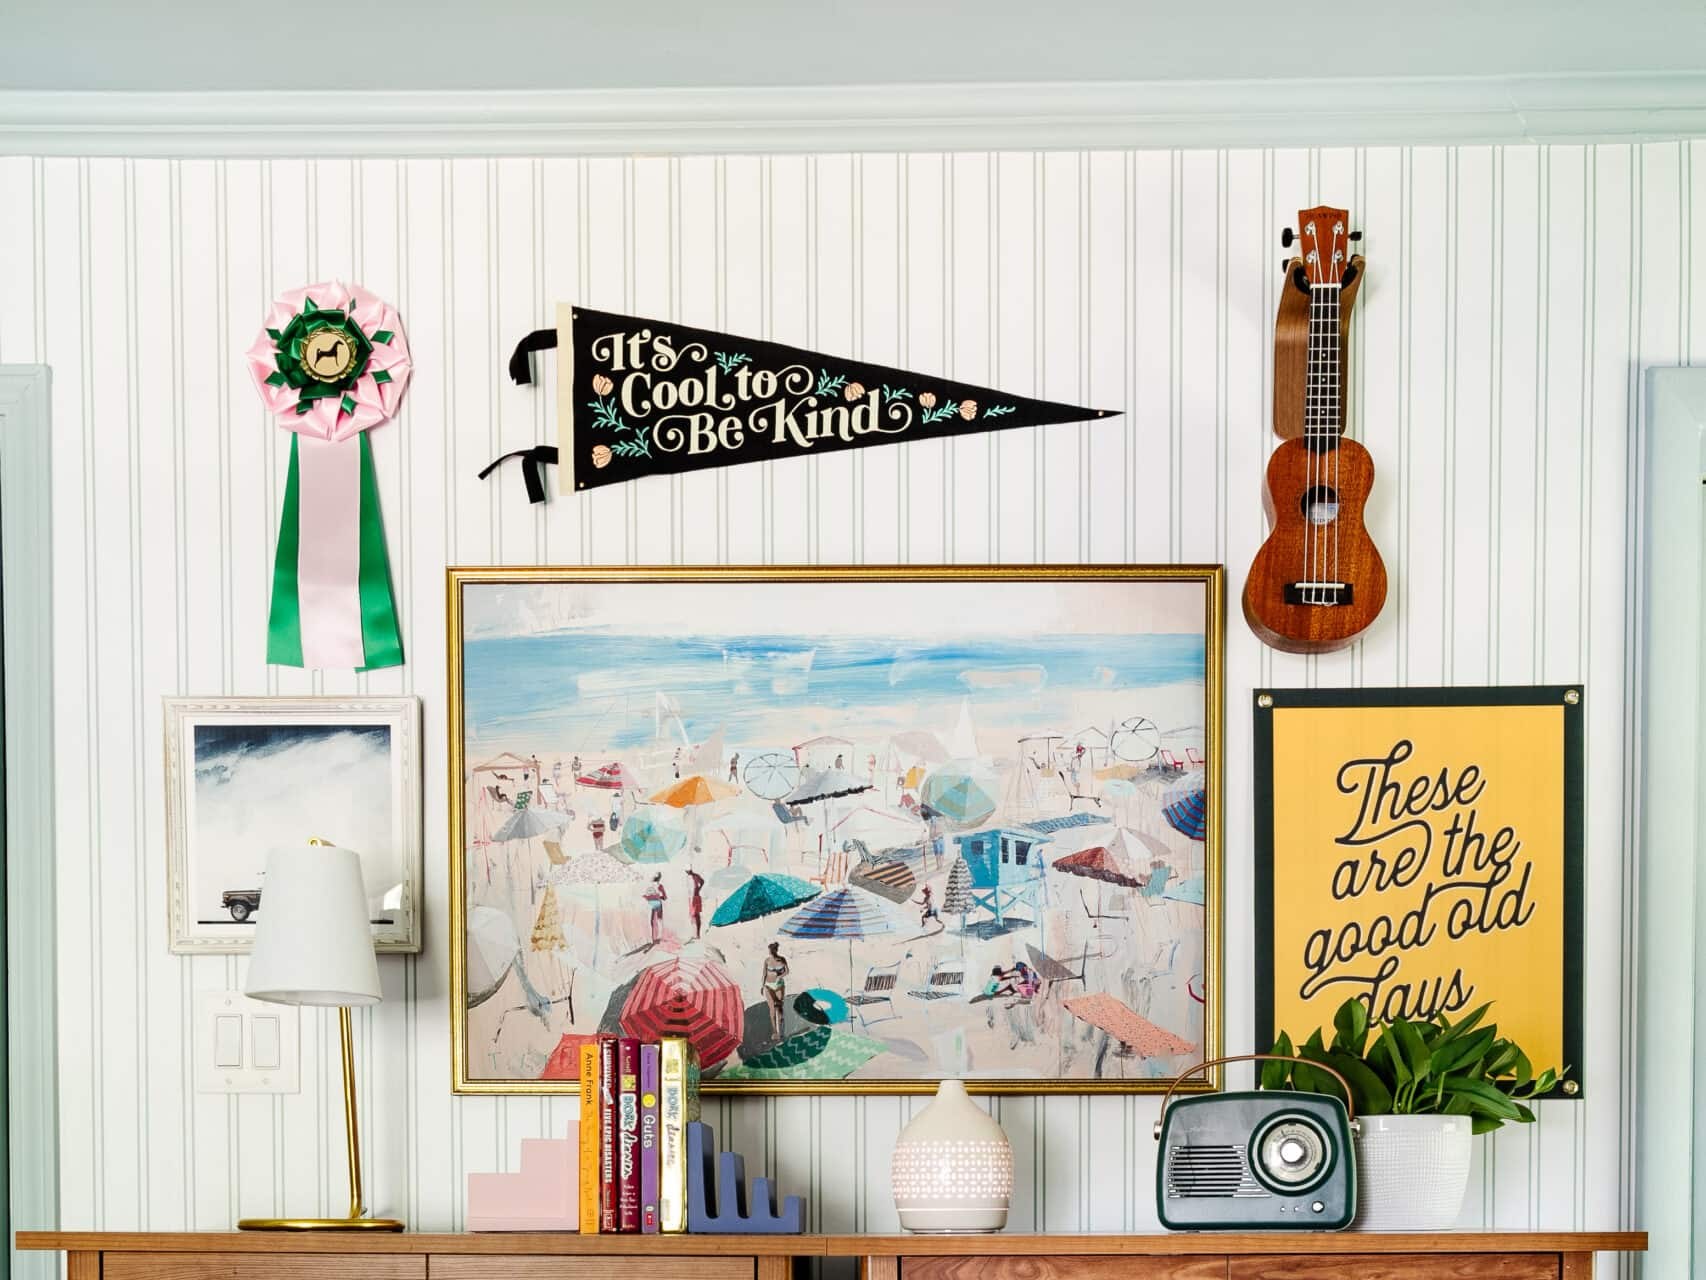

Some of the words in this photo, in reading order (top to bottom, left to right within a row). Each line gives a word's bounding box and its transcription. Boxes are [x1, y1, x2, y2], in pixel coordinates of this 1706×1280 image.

[591, 329, 708, 372] It's
[620, 366, 734, 418] Cool
[733, 364, 813, 403] to
[653, 413, 744, 455] Be
[750, 388, 913, 448] Kind
[1334, 739, 1487, 845] These
[1331, 826, 1432, 901] are
[1443, 810, 1520, 877] the
[1300, 883, 1437, 996] good
[1437, 861, 1536, 939] old
[585, 1053, 593, 1077] Anne
[585, 1079, 593, 1105] Frank
[643, 1114, 656, 1149] Guts
